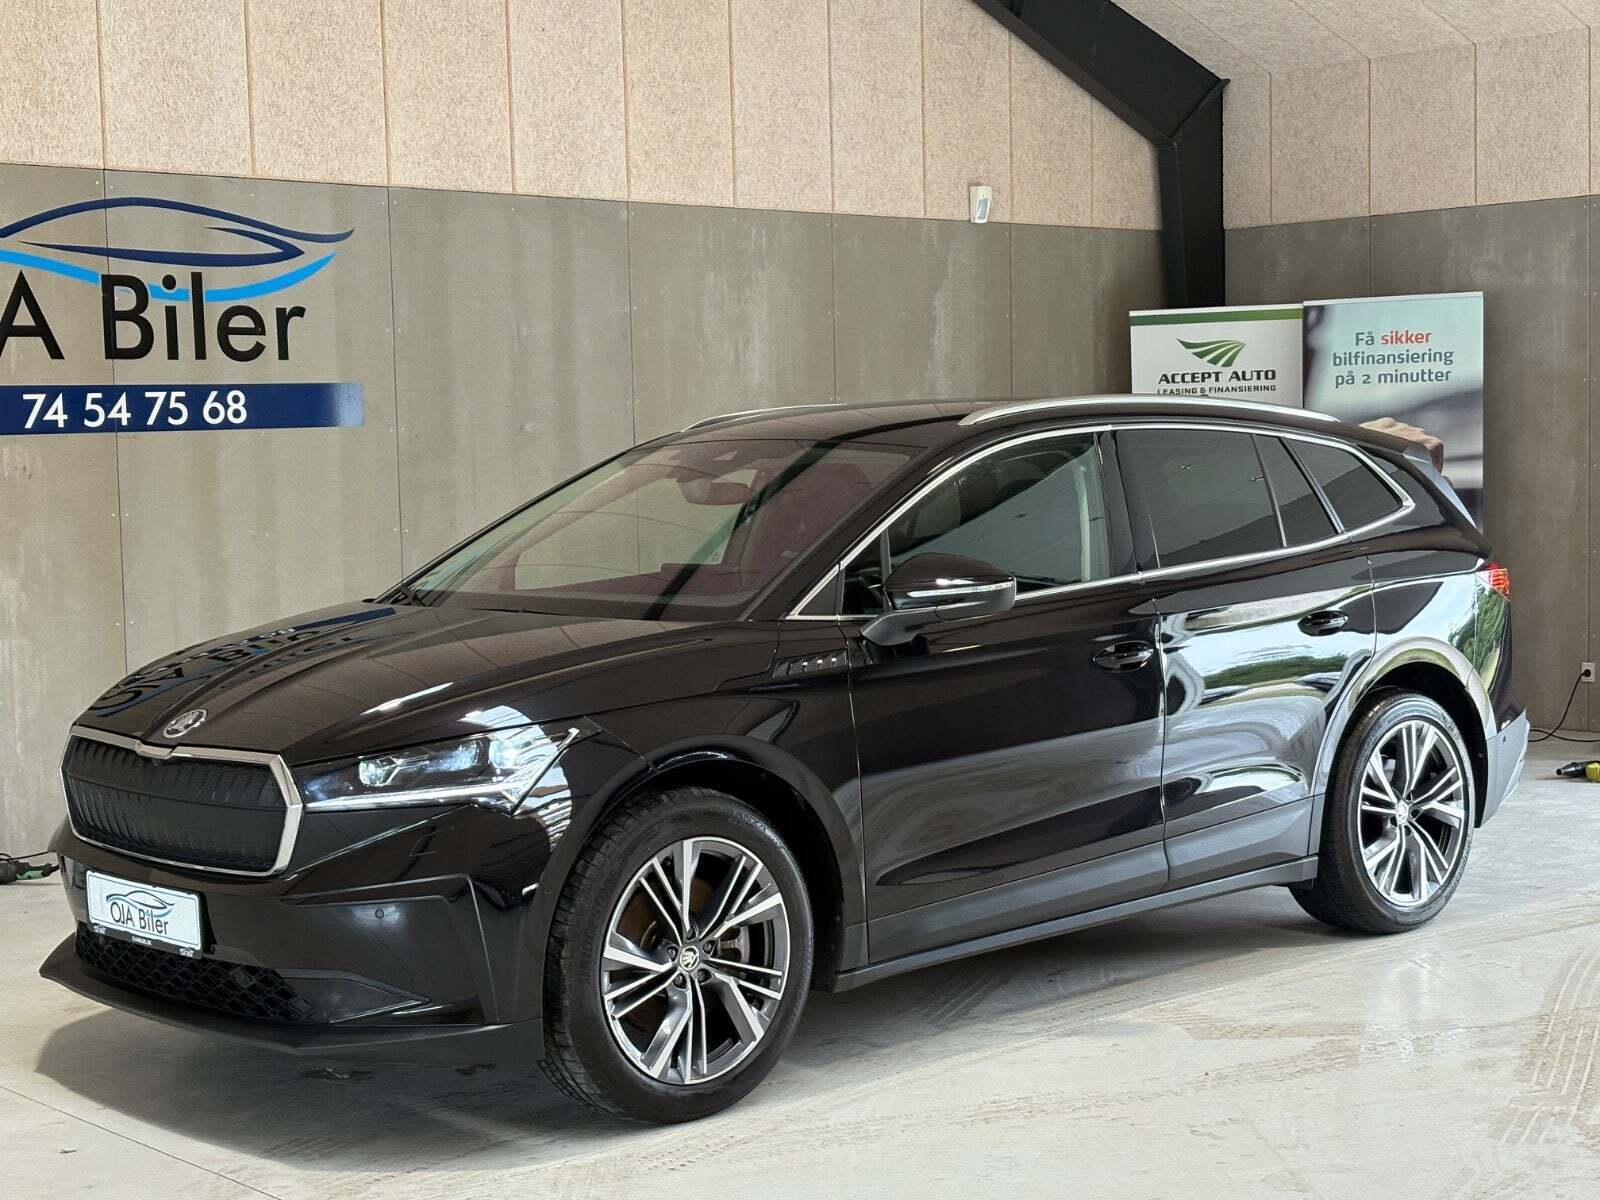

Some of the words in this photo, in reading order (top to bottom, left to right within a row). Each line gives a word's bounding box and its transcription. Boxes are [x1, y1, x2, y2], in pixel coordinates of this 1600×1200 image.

[0, 270, 65, 360] A
[101, 271, 306, 362] Biler
[1355, 330, 1375, 346] Få
[1380, 329, 1432, 345] sikker
[1332, 348, 1455, 367] bilfinansiering
[1158, 371, 1222, 384] ACCEPT
[1228, 369, 1276, 382] AUTO
[1335, 370, 1355, 388] på
[1362, 374, 1371, 384] 2
[1377, 368, 1452, 384] minutter
[1157, 387, 1198, 395] LEASING
[1208, 384, 1276, 394] FINANSIERING
[22, 392, 68, 428] 74
[83, 391, 131, 427] 54
[144, 391, 188, 426] 75
[202, 390, 247, 425] 68
[110, 901, 135, 928] OJA
[138, 908, 169, 935] Biler
